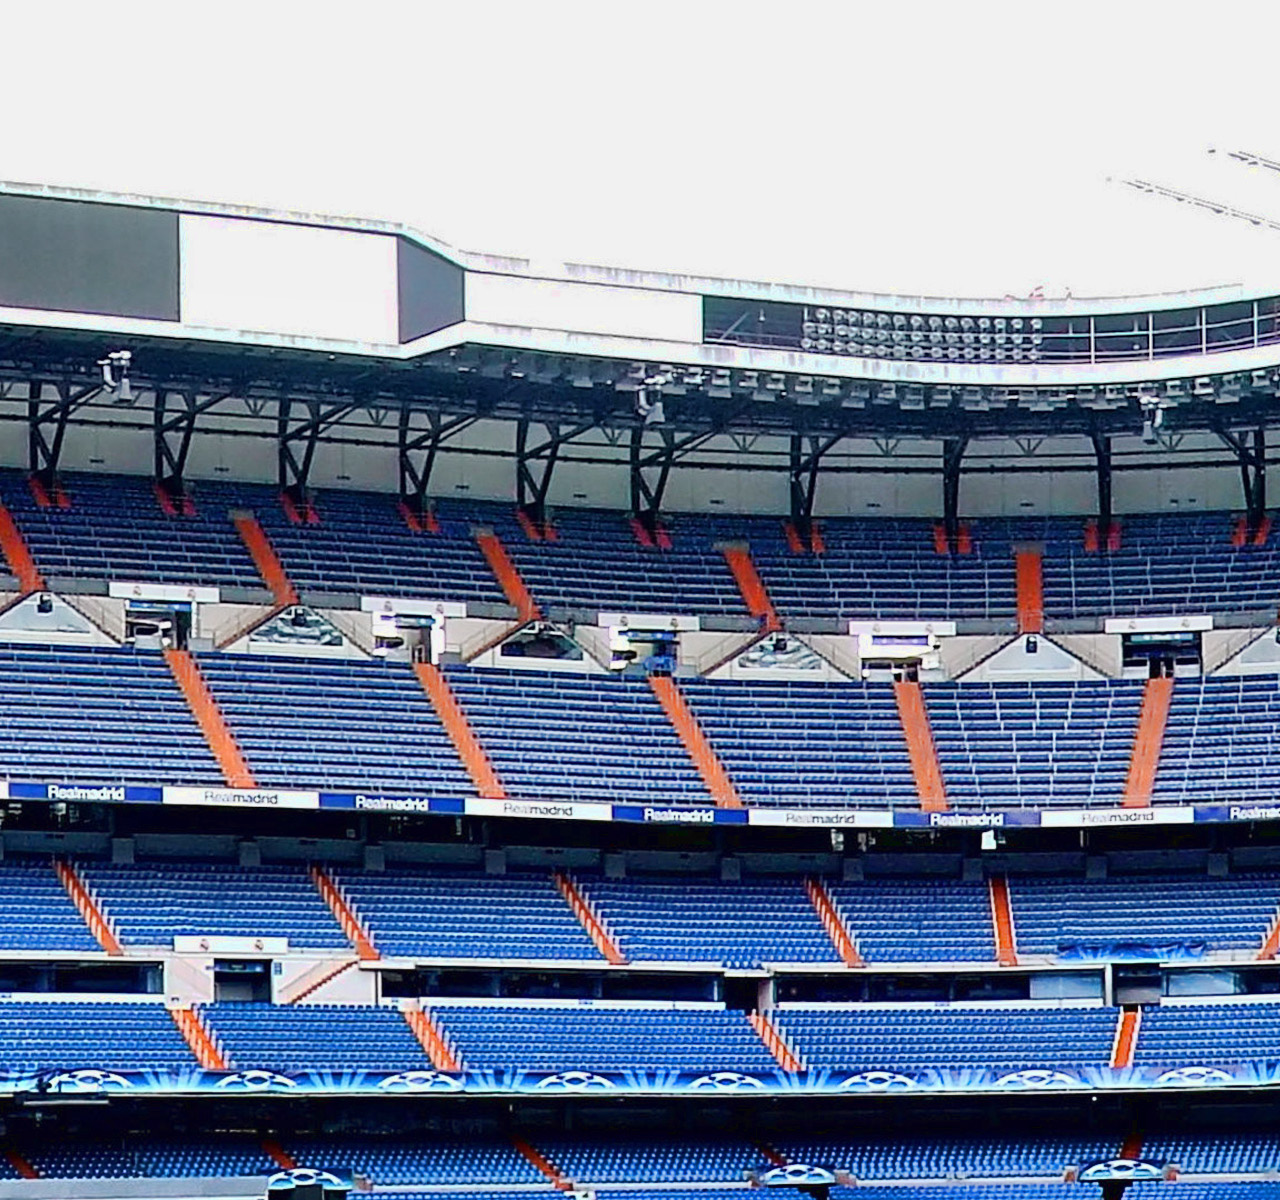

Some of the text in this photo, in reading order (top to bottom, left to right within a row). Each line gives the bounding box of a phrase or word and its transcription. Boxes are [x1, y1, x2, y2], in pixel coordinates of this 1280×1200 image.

[48, 785, 124, 801] Realmadrid
[204, 790, 278, 806] Realmadrid
[356, 796, 428, 811] Realmadrid
[504, 801, 573, 818] Realmadrid
[644, 807, 713, 823] Realmadrid
[786, 811, 855, 826] Realmadrid
[931, 811, 1003, 827] Realmadrid
[1081, 809, 1154, 824] Realmadrid
